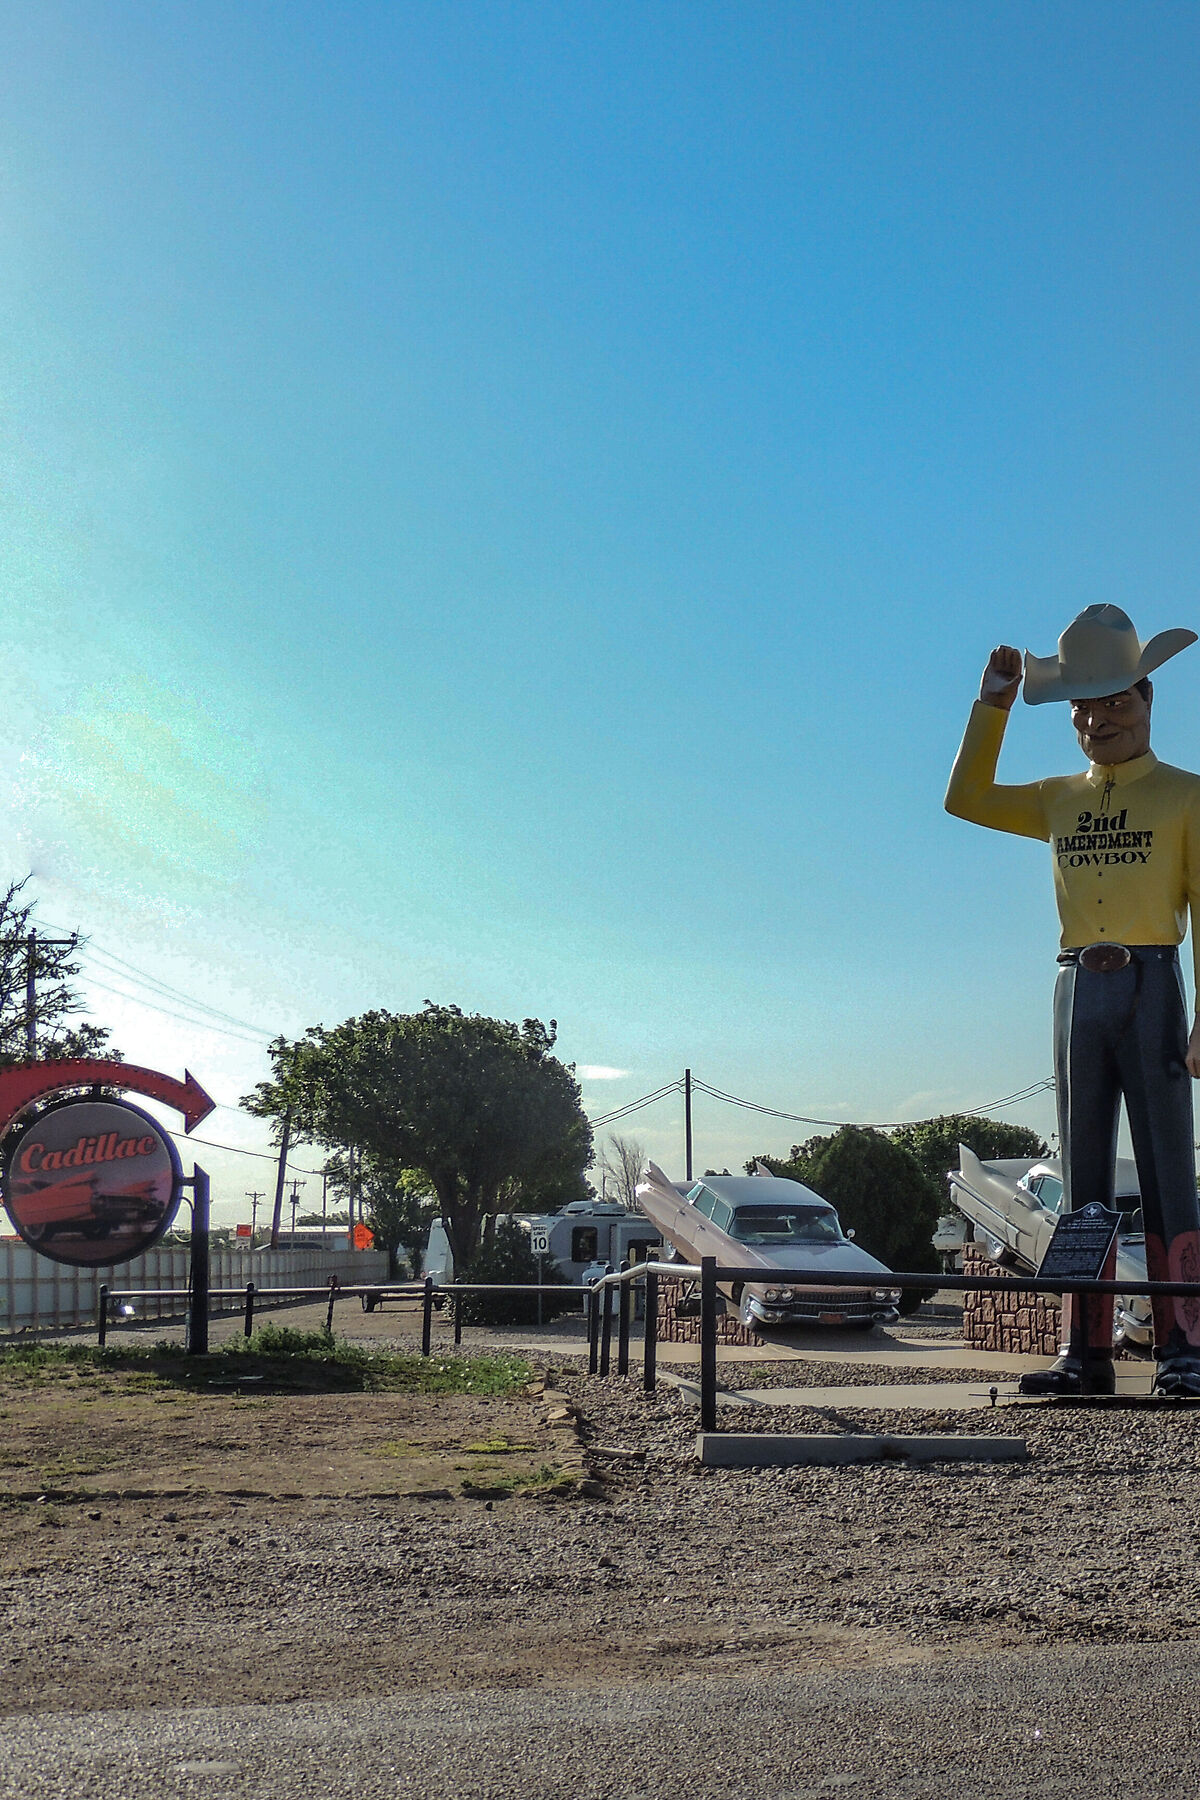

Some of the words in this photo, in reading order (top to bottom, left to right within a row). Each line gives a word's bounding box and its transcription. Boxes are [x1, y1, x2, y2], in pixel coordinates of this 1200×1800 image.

[1076, 809, 1127, 833] 2nd
[1057, 831, 1152, 854] AMENDMENT
[1058, 851, 1152, 869] COWBOY
[20, 1132, 157, 1174] Cadillac
[532, 1237, 547, 1250] 10
